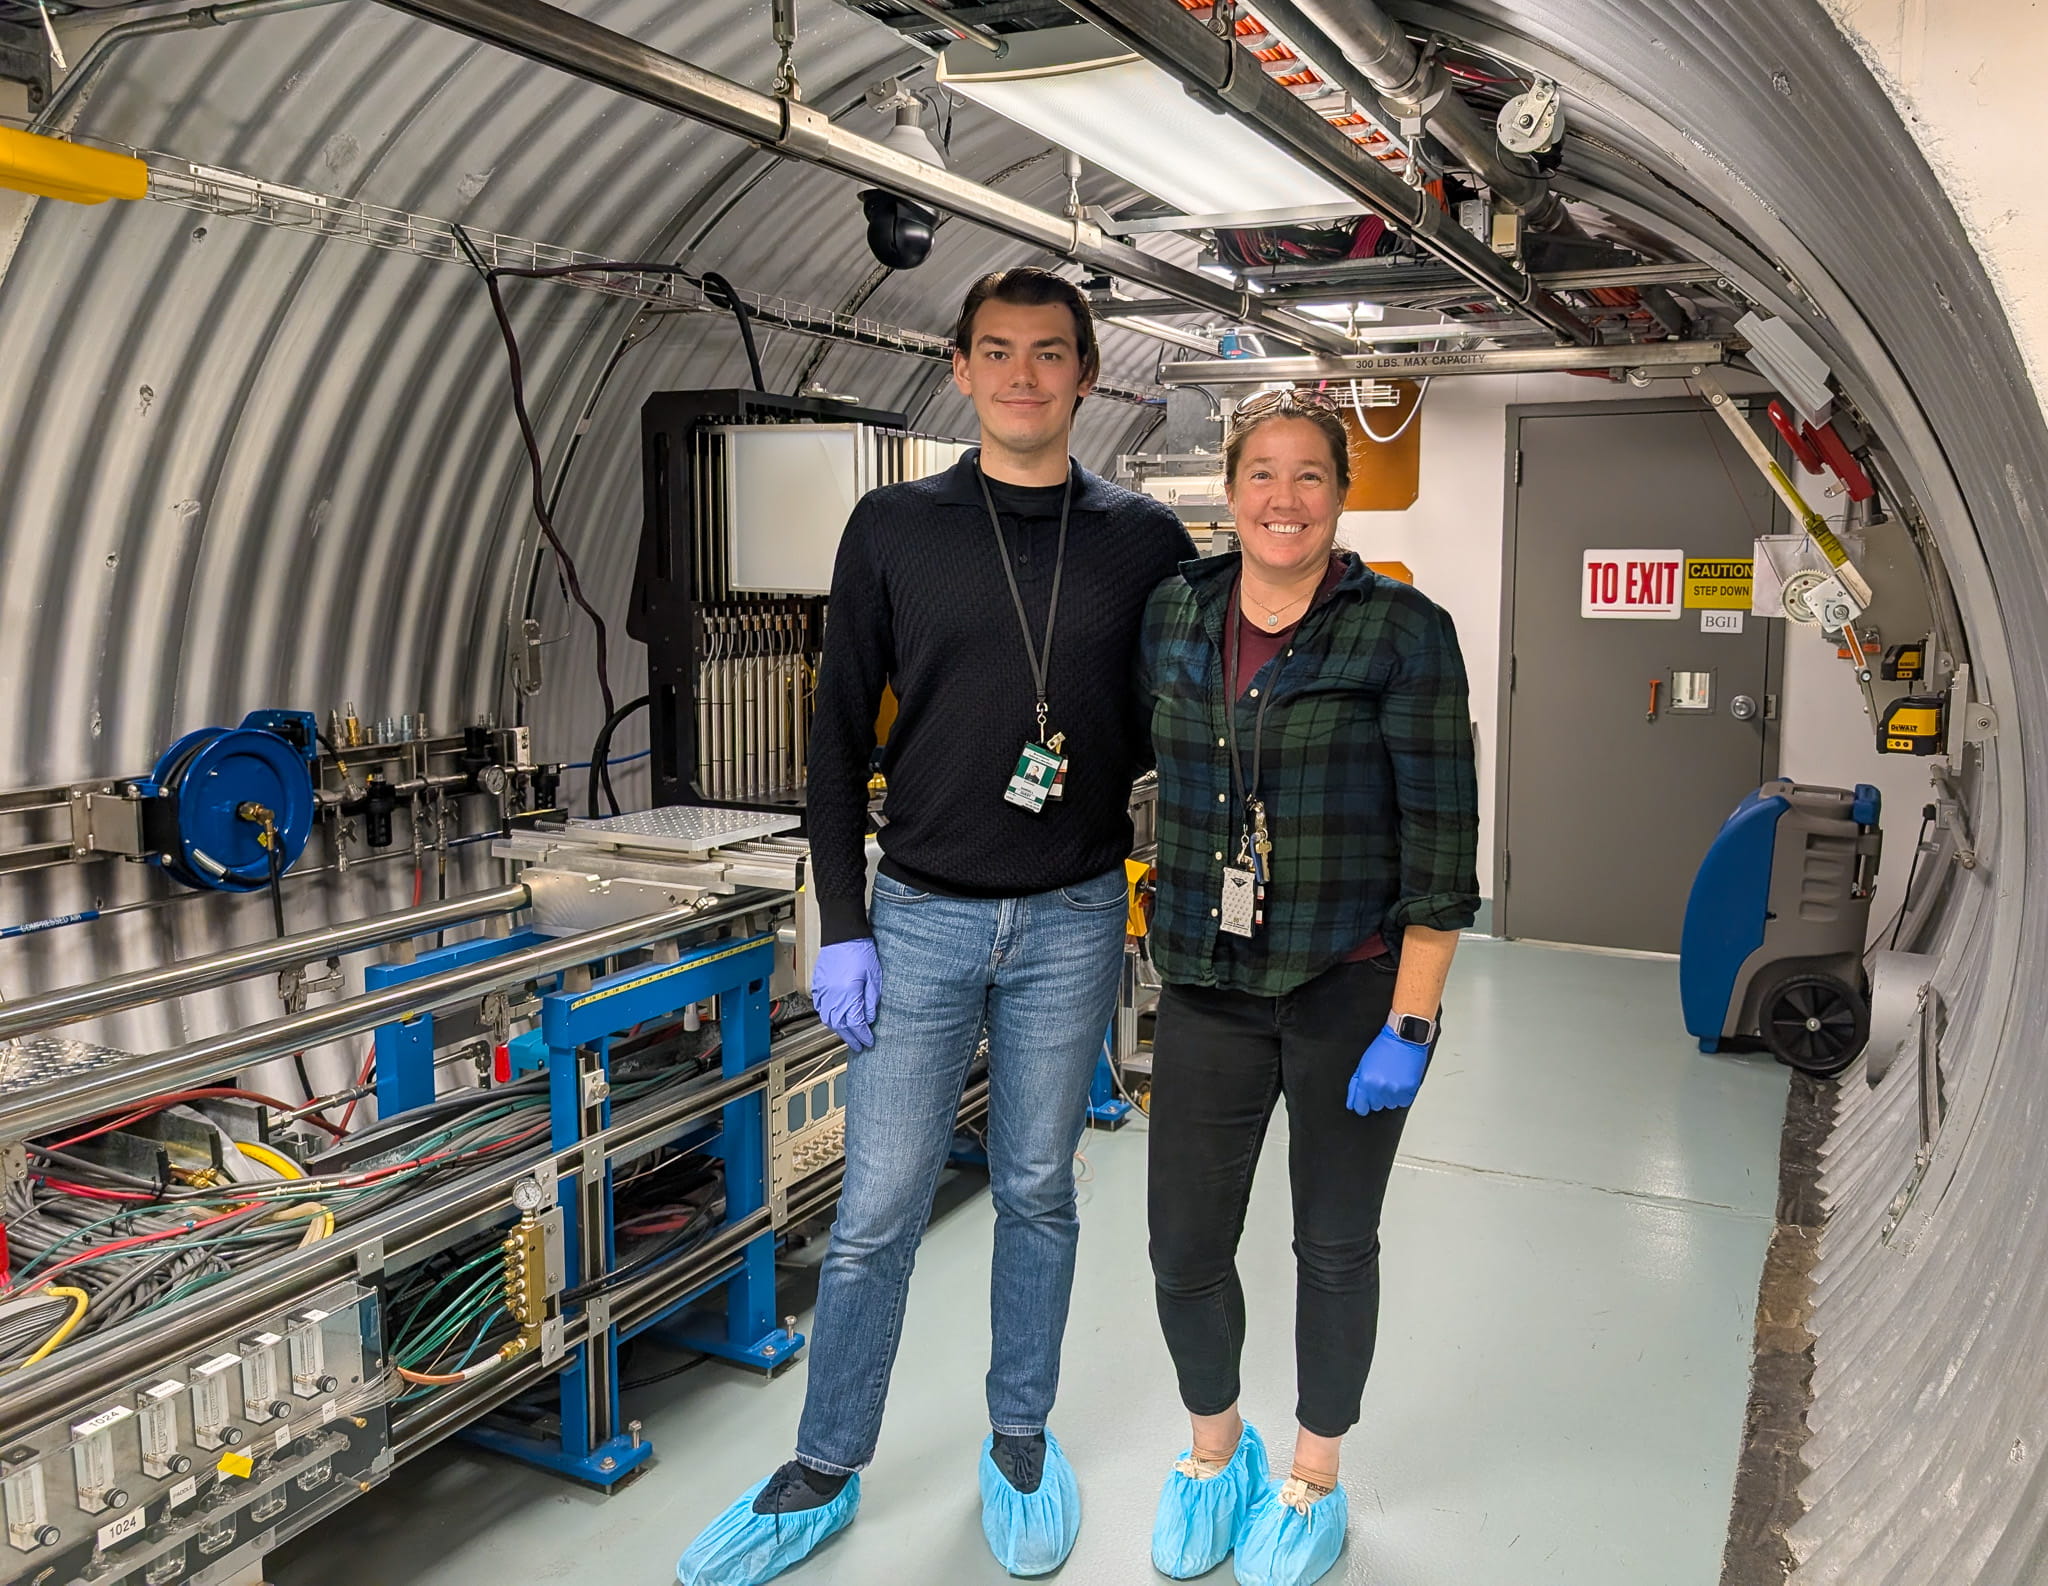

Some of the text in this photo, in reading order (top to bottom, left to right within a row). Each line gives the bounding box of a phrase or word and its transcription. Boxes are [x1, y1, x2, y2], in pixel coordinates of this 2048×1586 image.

[1356, 354, 1486, 369] 300 LBS. MAX CAPACITY
[1691, 564, 1753, 577] CAUTION
[1588, 561, 1679, 605] TO EXIT
[1693, 585, 1749, 596] STEP DOWN
[20, 916, 69, 932] COMPRESSED
[89, 1411, 120, 1427] 1024
[110, 1516, 136, 1538] 1024
